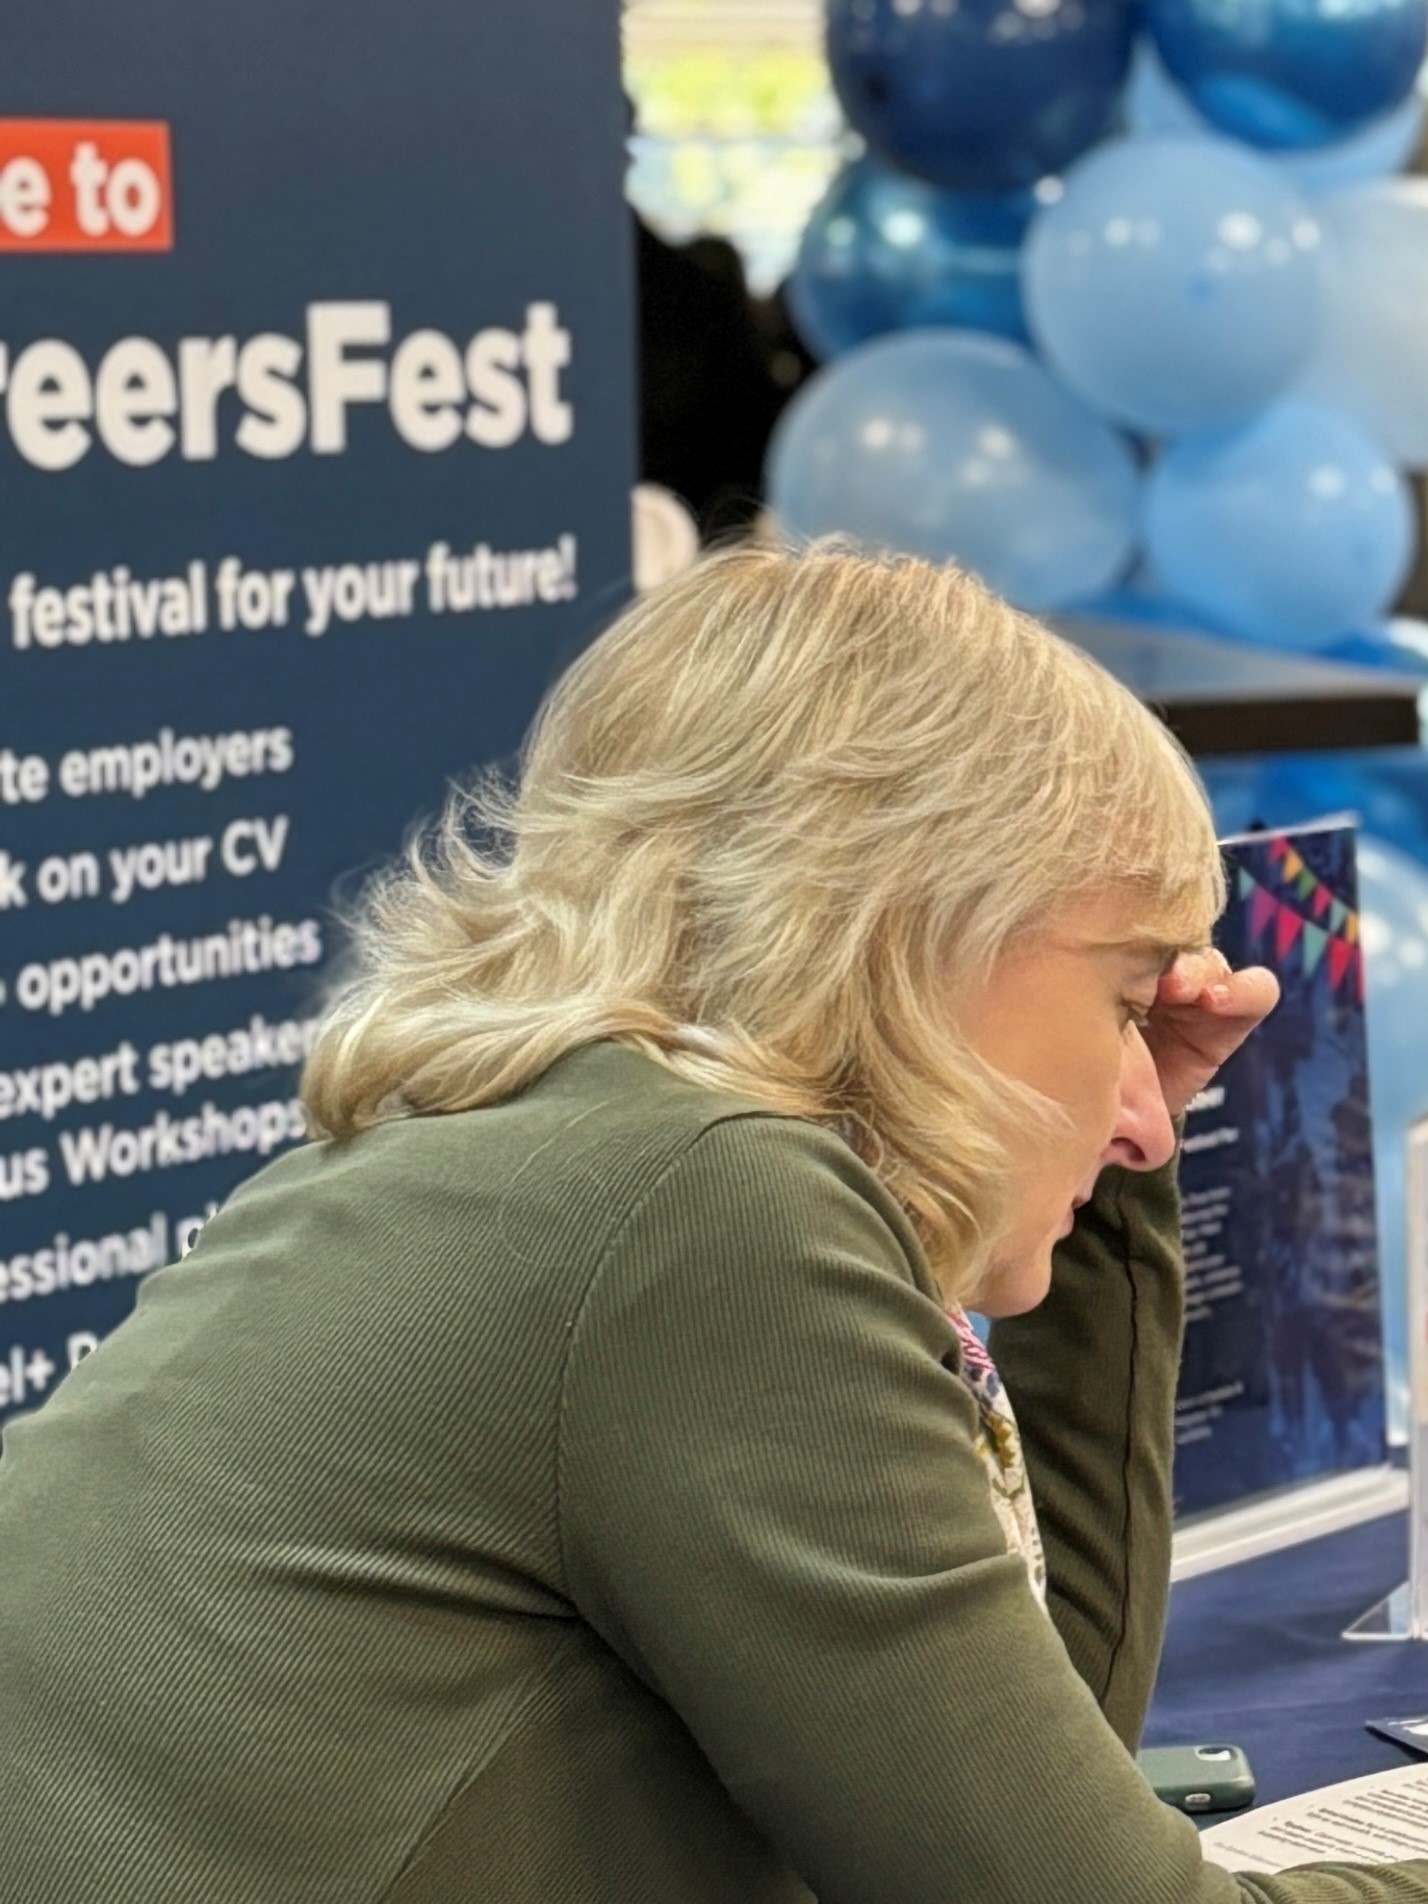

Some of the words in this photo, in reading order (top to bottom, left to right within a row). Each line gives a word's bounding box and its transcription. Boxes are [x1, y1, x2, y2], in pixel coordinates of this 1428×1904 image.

[71, 142, 160, 237] to
[0, 301, 573, 471] eersFest
[10, 561, 206, 649] festival
[217, 557, 295, 629] for
[303, 559, 419, 637] your
[427, 533, 578, 613] future!
[59, 726, 294, 799] employers
[37, 853, 99, 903] on
[109, 836, 213, 905] your
[221, 814, 289, 877] CV
[17, 914, 323, 1015] opportunities
[148, 1014, 320, 1097] speaker
[59, 1097, 307, 1195] Workshops
